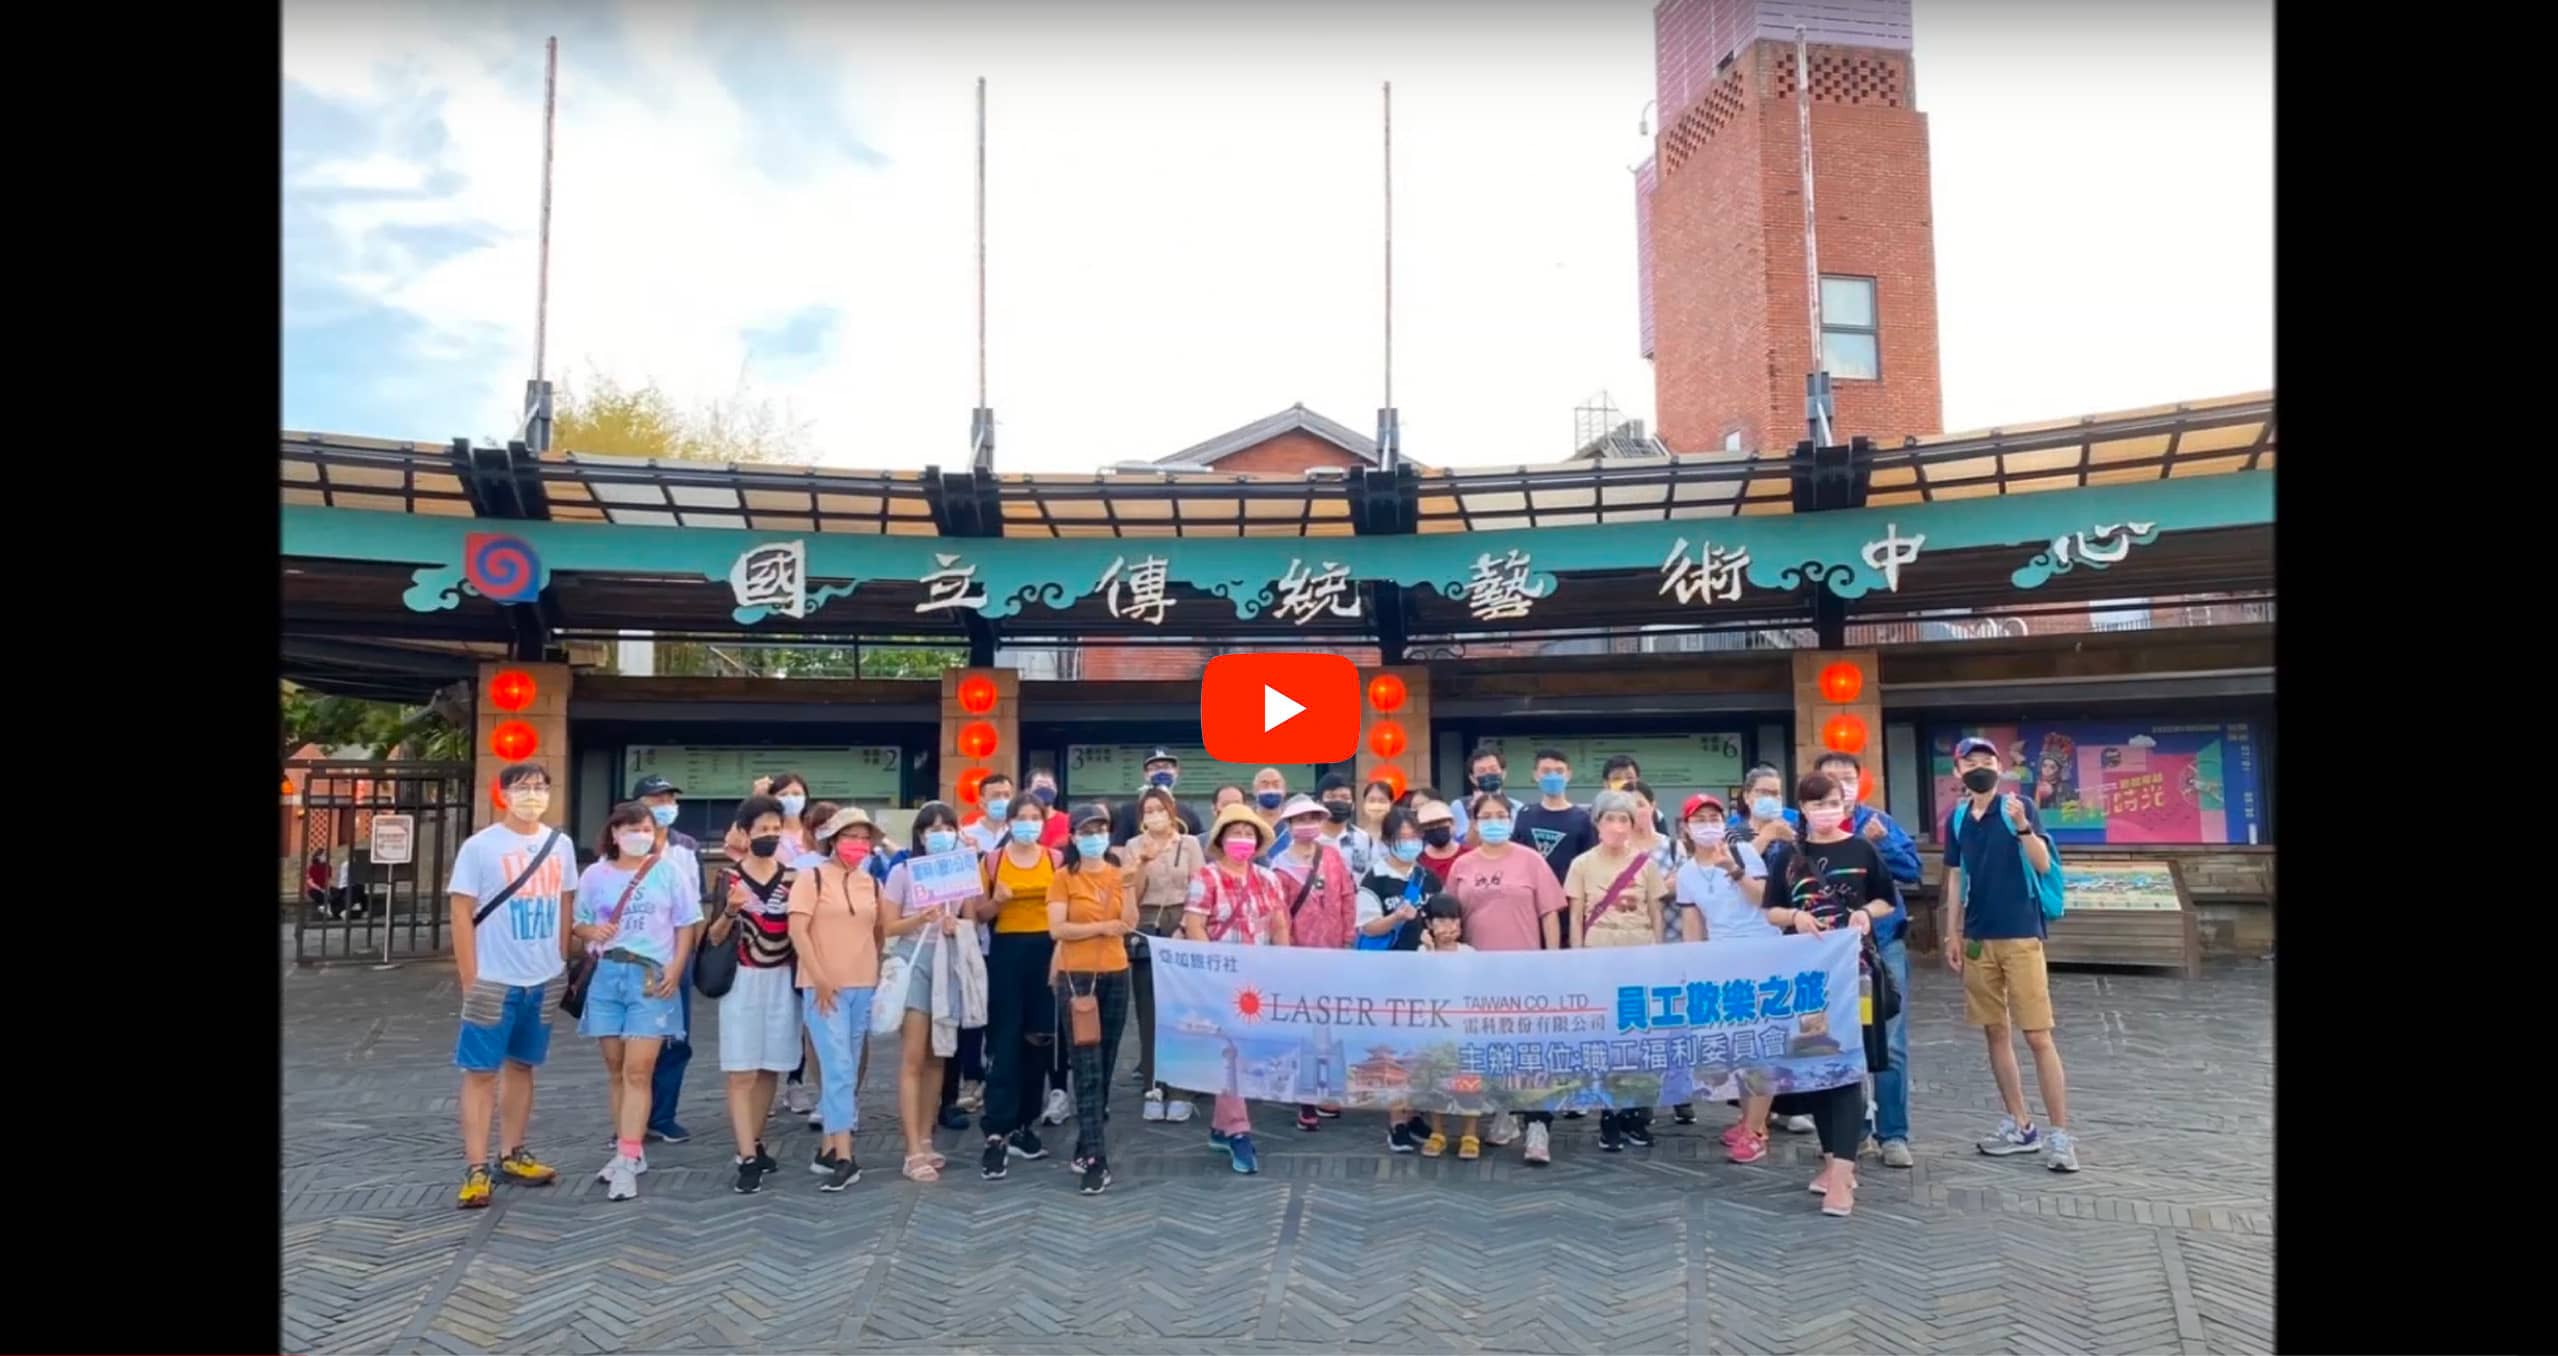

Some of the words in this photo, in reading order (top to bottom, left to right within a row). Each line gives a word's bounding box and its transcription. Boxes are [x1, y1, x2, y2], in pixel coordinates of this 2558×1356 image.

[1722, 736, 1738, 758] 6
[631, 749, 644, 773] 1
[882, 749, 898, 773] 2
[1070, 748, 1085, 771] 3
[510, 896, 558, 940] MEAN
[1271, 993, 1376, 1026] LASER
[1385, 998, 1452, 1028] TEK
[1463, 995, 1521, 1011] TAIWAN
[1462, 1014, 1605, 1035] 雷科股份有限公司
